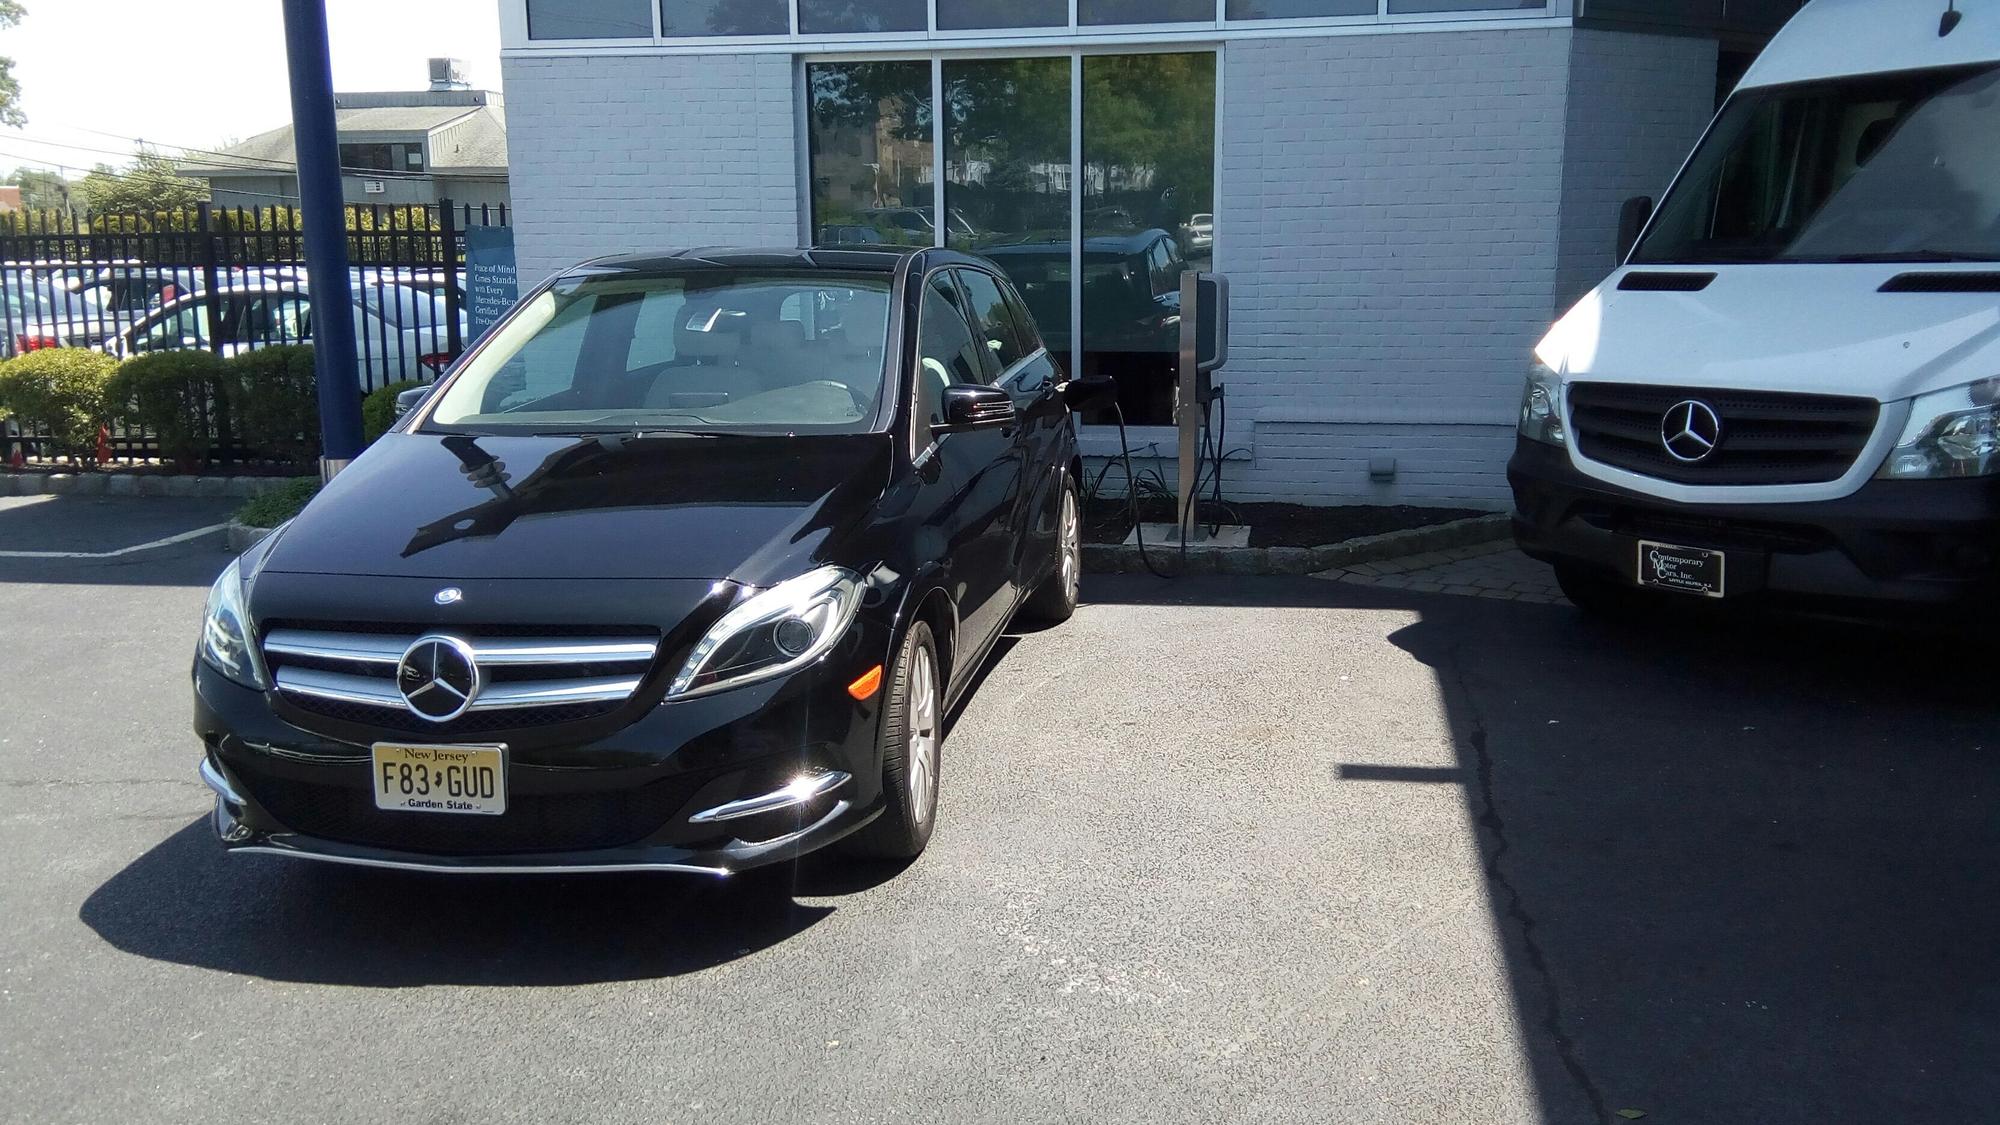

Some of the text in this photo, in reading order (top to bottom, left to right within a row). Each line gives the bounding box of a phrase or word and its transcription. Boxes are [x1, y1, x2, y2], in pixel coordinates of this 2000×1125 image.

[488, 264, 496, 273] of
[497, 264, 516, 274] Mind
[486, 286, 504, 296] Every
[475, 305, 499, 315] Certified
[1649, 550, 1704, 568] Contemporary
[1653, 558, 1677, 570] Motor
[1680, 571, 1695, 580] Inc.
[404, 748, 468, 763] New Jersey
[408, 798, 473, 810] Garden State
